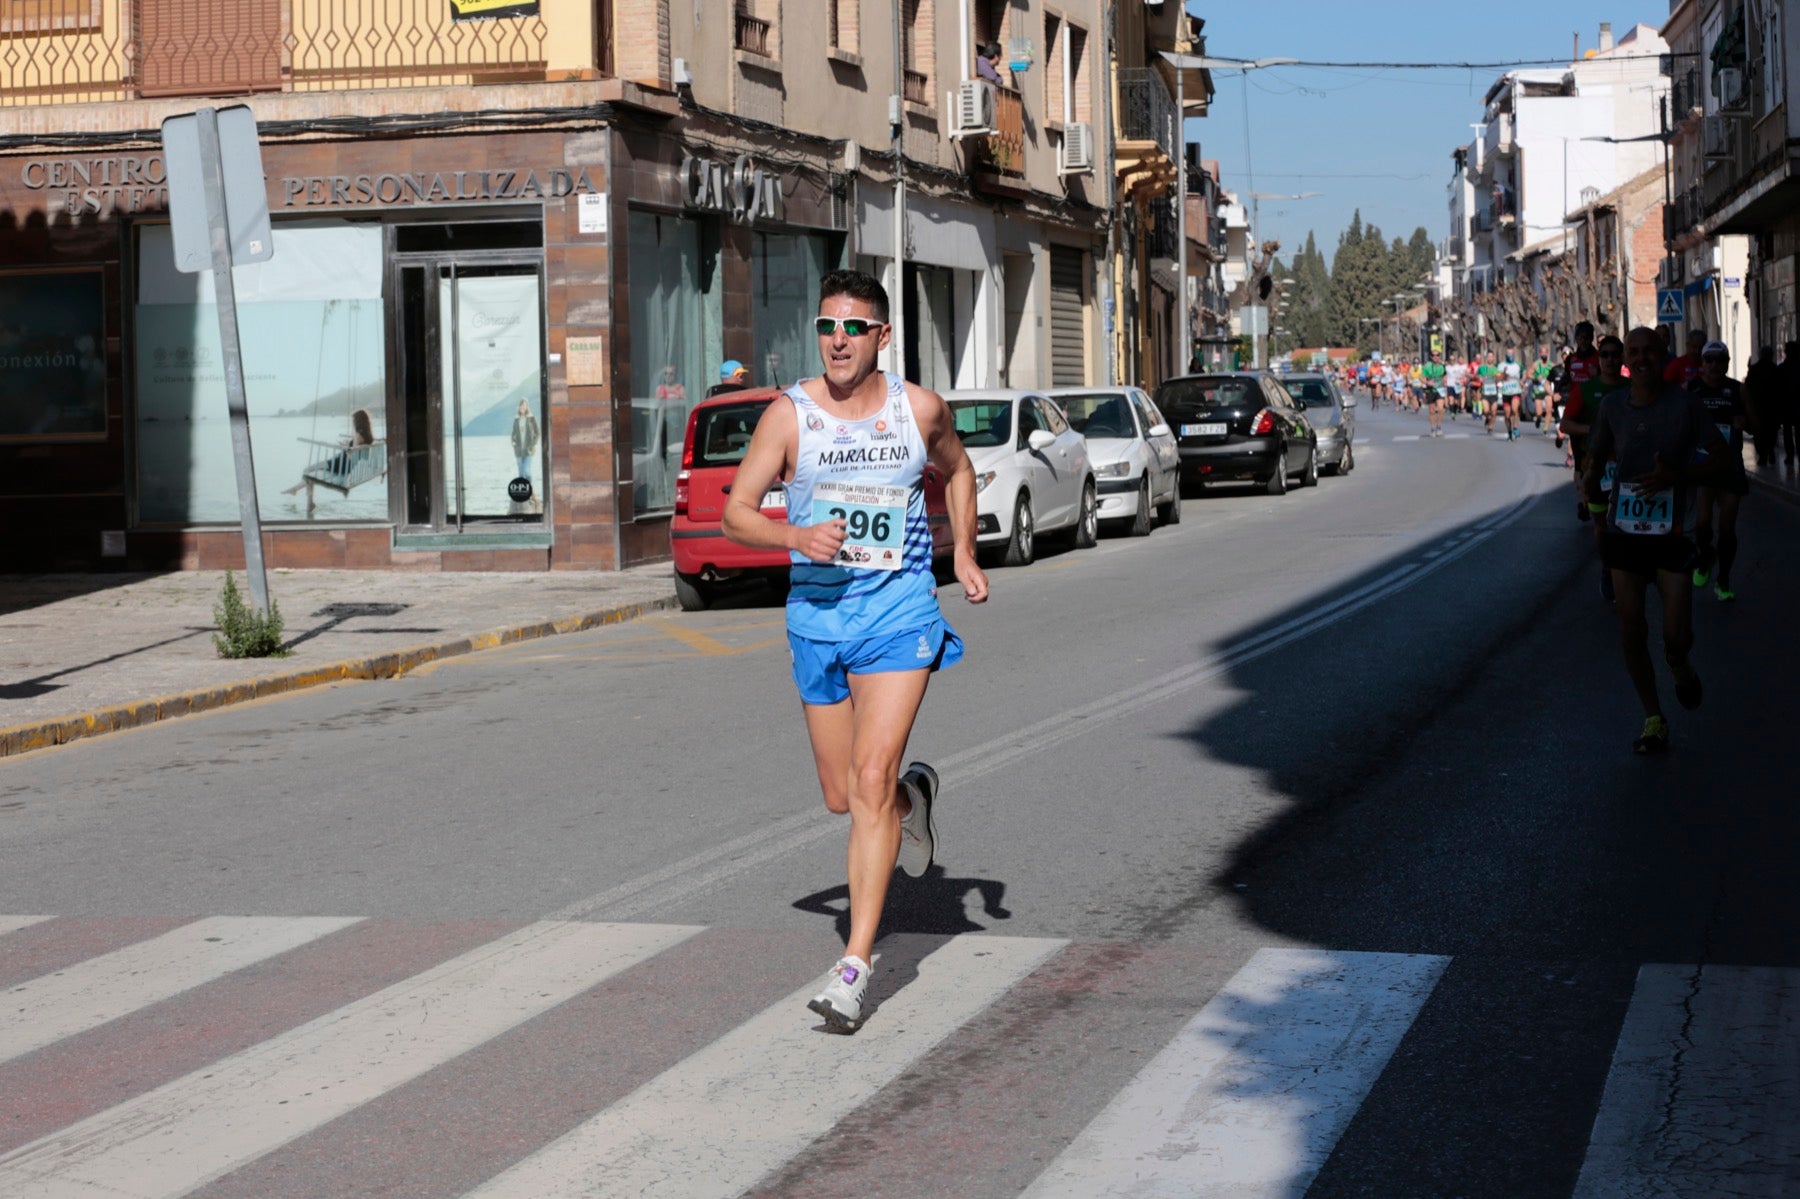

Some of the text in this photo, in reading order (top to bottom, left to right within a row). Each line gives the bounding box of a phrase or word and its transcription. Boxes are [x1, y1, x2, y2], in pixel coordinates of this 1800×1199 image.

[21, 155, 167, 190] CENTRO
[284, 167, 600, 207] PERSONALIZADA
[61, 185, 169, 217] ESTET
[818, 445, 910, 466] MARACENA
[861, 463, 902, 471] ATLETISMO
[838, 484, 853, 492] GRAN
[854, 485, 876, 495] PREMIO
[877, 487, 884, 496] DE
[886, 488, 905, 497] FONDO
[844, 493, 880, 504] DIPUTACIÓN
[1621, 498, 1668, 519] 1071
